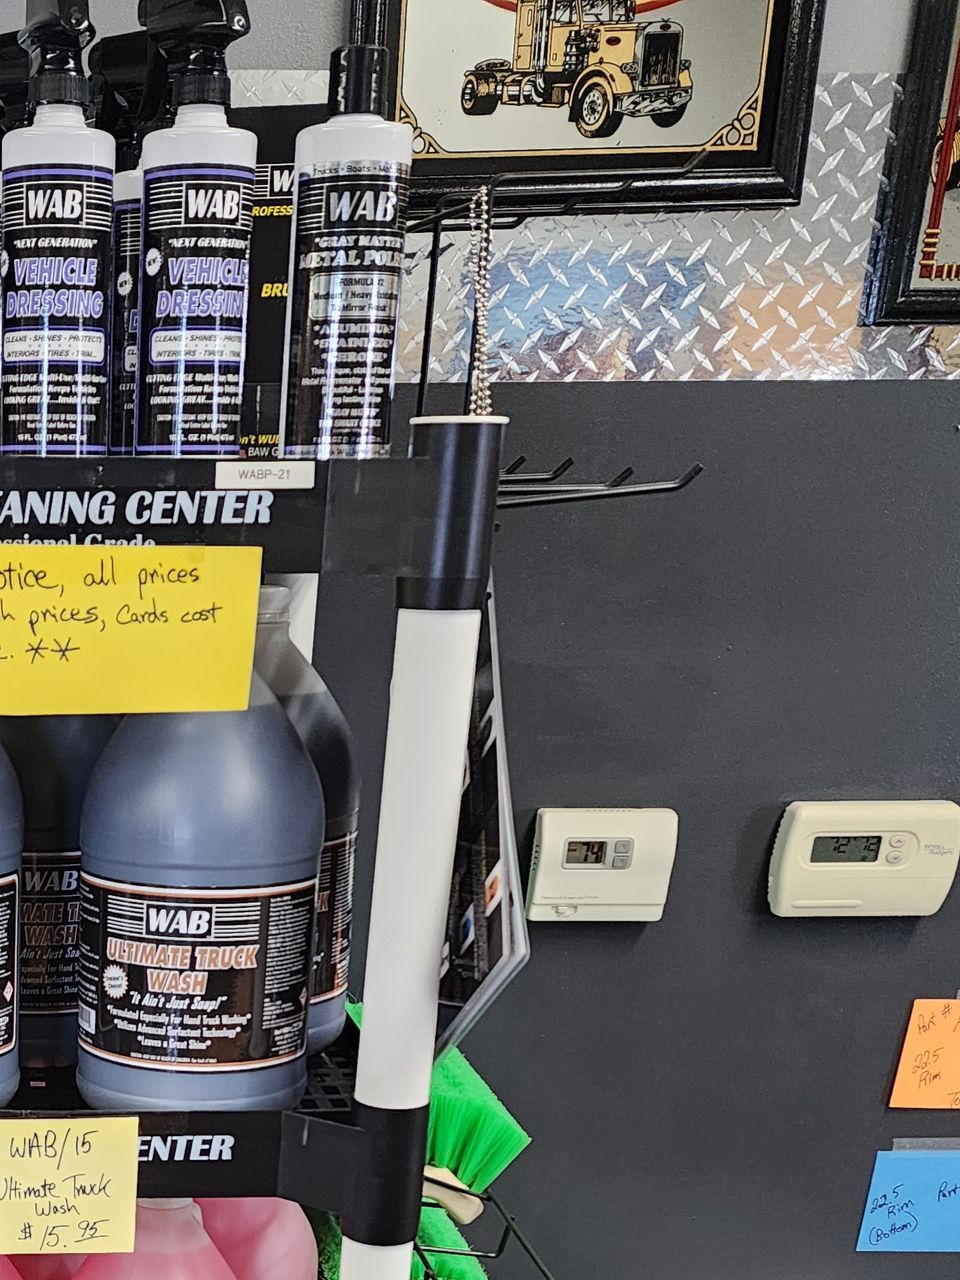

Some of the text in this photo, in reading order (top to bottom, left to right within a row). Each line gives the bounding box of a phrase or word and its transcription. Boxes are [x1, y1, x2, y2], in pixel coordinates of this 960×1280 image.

[346, 165, 371, 173] Boats
[28, 188, 82, 218] WAB
[187, 189, 240, 219] WAB
[329, 190, 397, 222] WAB
[14, 257, 98, 287] VEHICLE
[6, 289, 105, 319] DRESSING
[156, 289, 244, 318] DRESSIN
[6, 335, 27, 344] CLEANS
[190, 334, 217, 342] SHINES
[7, 349, 69, 358] INTERIORS TIRES
[248, 446, 270, 457] BAW
[238, 468, 291, 481] WABP-21
[125, 489, 274, 525] CENTER
[83, 558, 117, 586] all
[137, 564, 200, 599] prices
[27, 604, 107, 636] prices,
[116, 603, 170, 626] Cards
[180, 603, 223, 624] cost
[25, 870, 78, 893] WAB
[148, 908, 211, 935] WAB
[25, 925, 78, 946] WASH
[106, 937, 261, 970] ULTIMATE TRUCK
[146, 968, 209, 995] WASH
[142, 993, 190, 1010] Ain't Just
[918, 1071, 941, 1089] Rim
[8, 1127, 100, 1170] WAB/15
[138, 1134, 235, 1162] ENTER
[62, 1173, 113, 1199] Truck
[33, 1199, 80, 1216] Wash
[887, 1199, 915, 1219] Rim
[18, 1223, 32, 1240] $
[869, 1210, 919, 1246] (Bottom)
